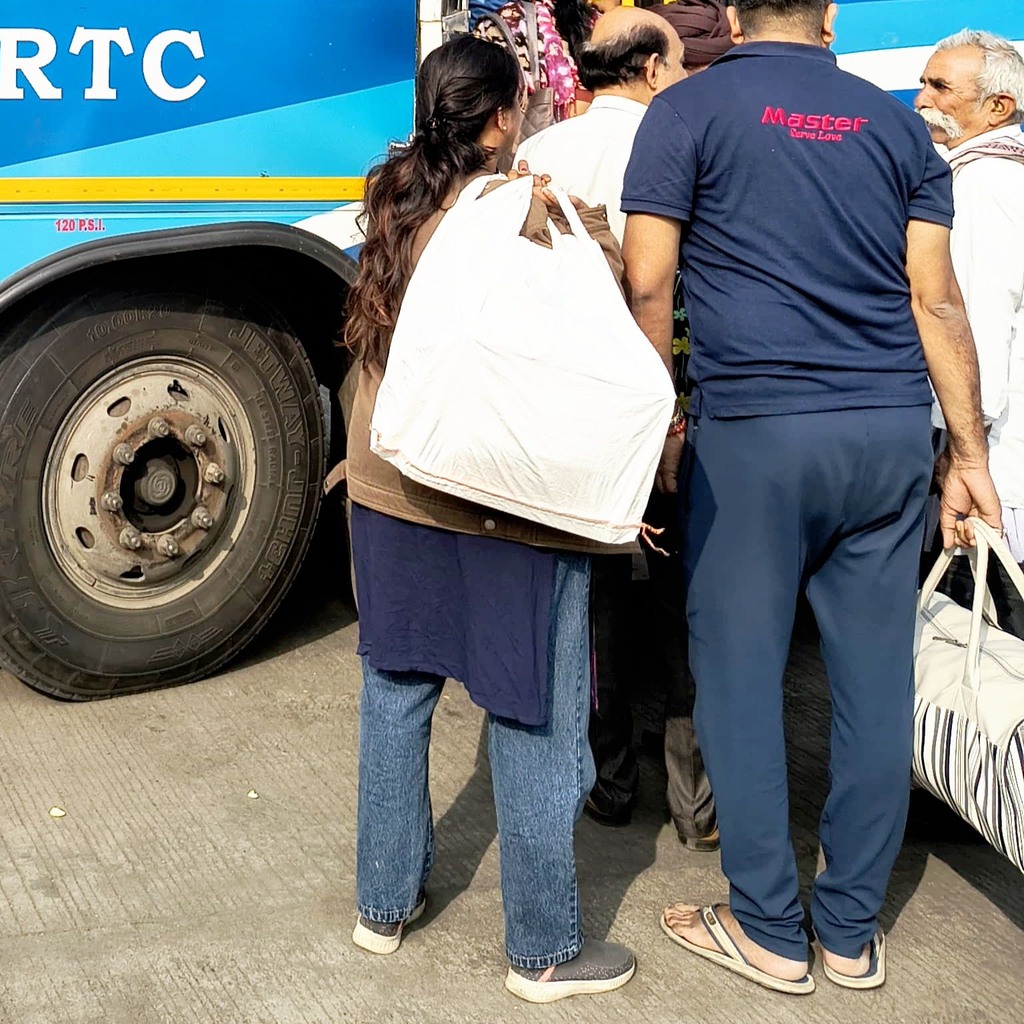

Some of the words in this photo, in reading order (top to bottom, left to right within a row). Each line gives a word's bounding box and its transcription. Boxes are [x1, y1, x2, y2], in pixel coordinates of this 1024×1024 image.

[762, 106, 868, 132] Master
[817, 130, 842, 142] Love
[56, 219, 76, 232] 120
[79, 218, 106, 232] P.S.I.
